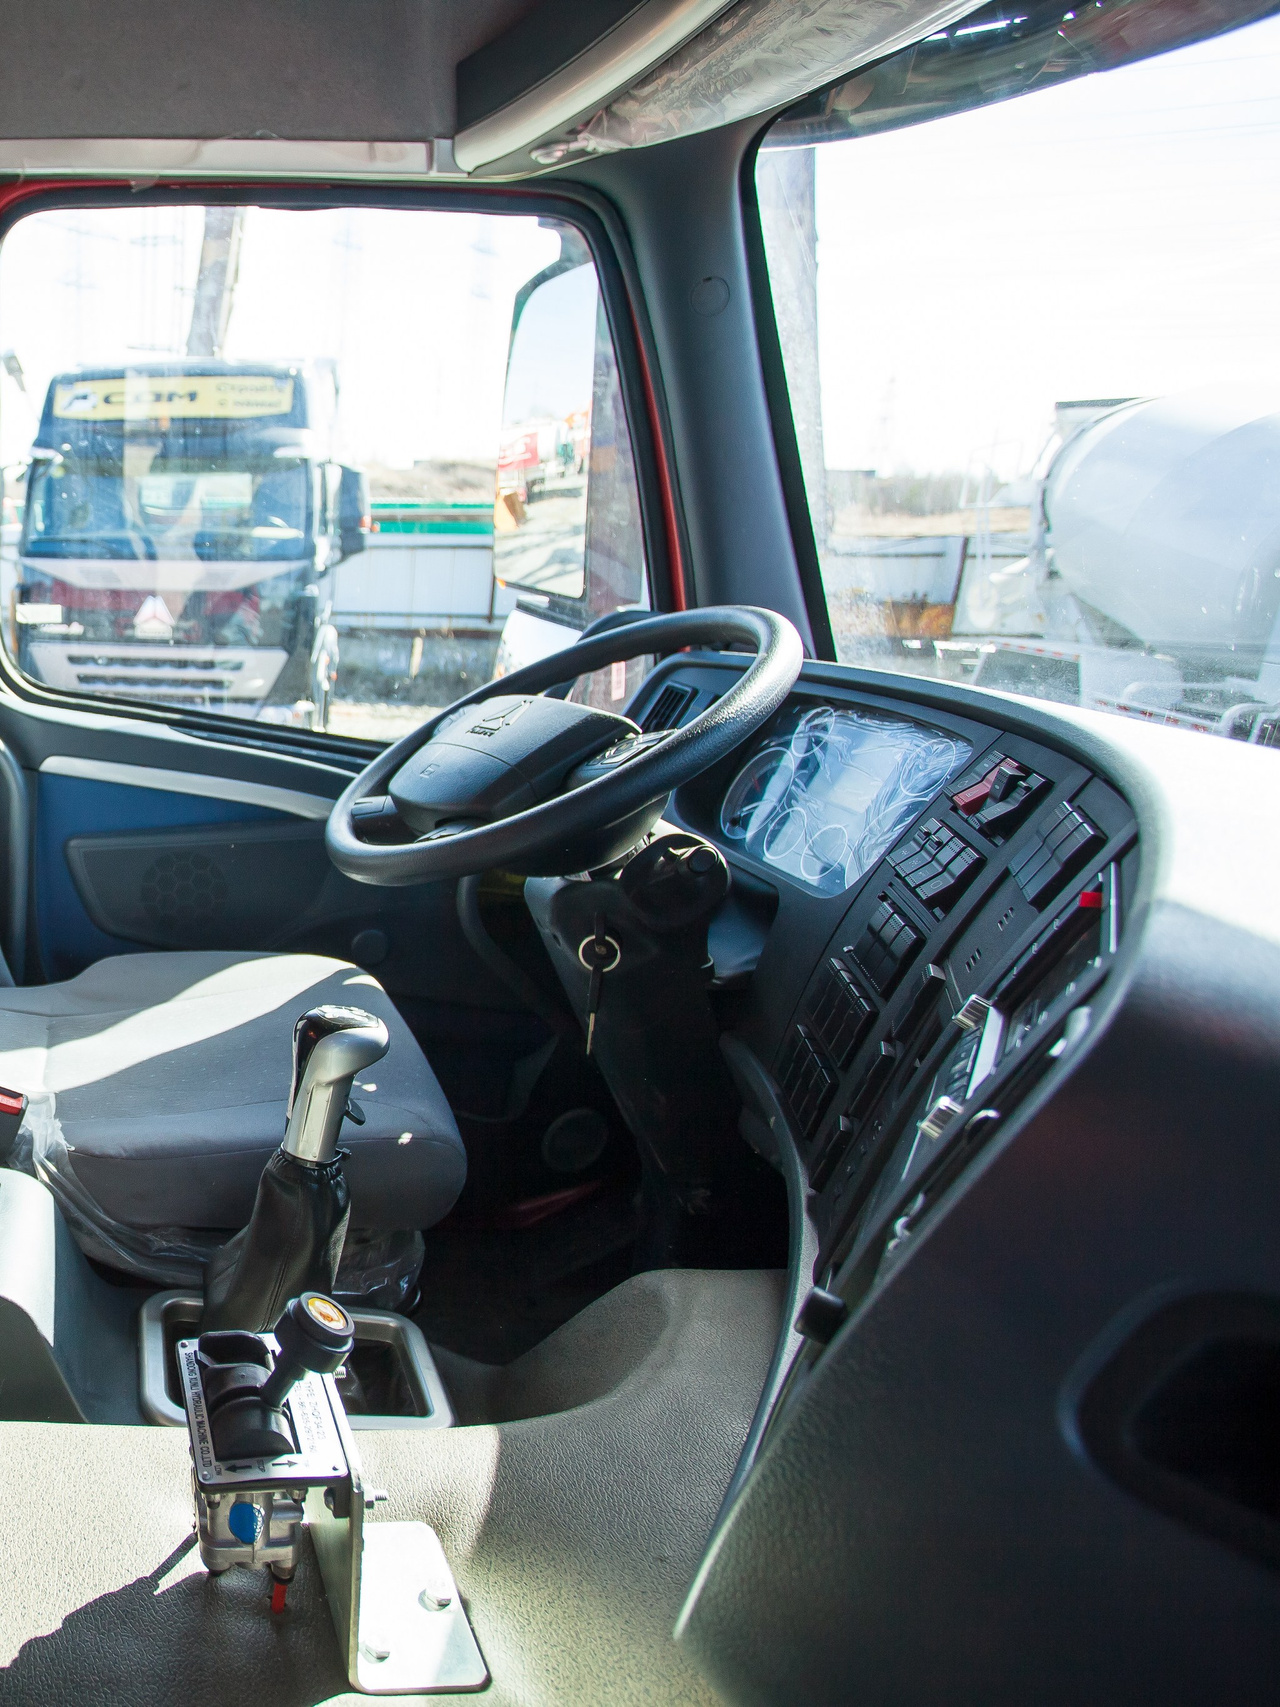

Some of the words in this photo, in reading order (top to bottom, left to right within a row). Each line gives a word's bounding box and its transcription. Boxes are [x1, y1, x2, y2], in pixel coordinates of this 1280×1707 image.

[185, 1352, 194, 1376] SHANDONG
[191, 1391, 205, 1419] HYDRAULIC
[196, 1420, 209, 1445] MACHINE
